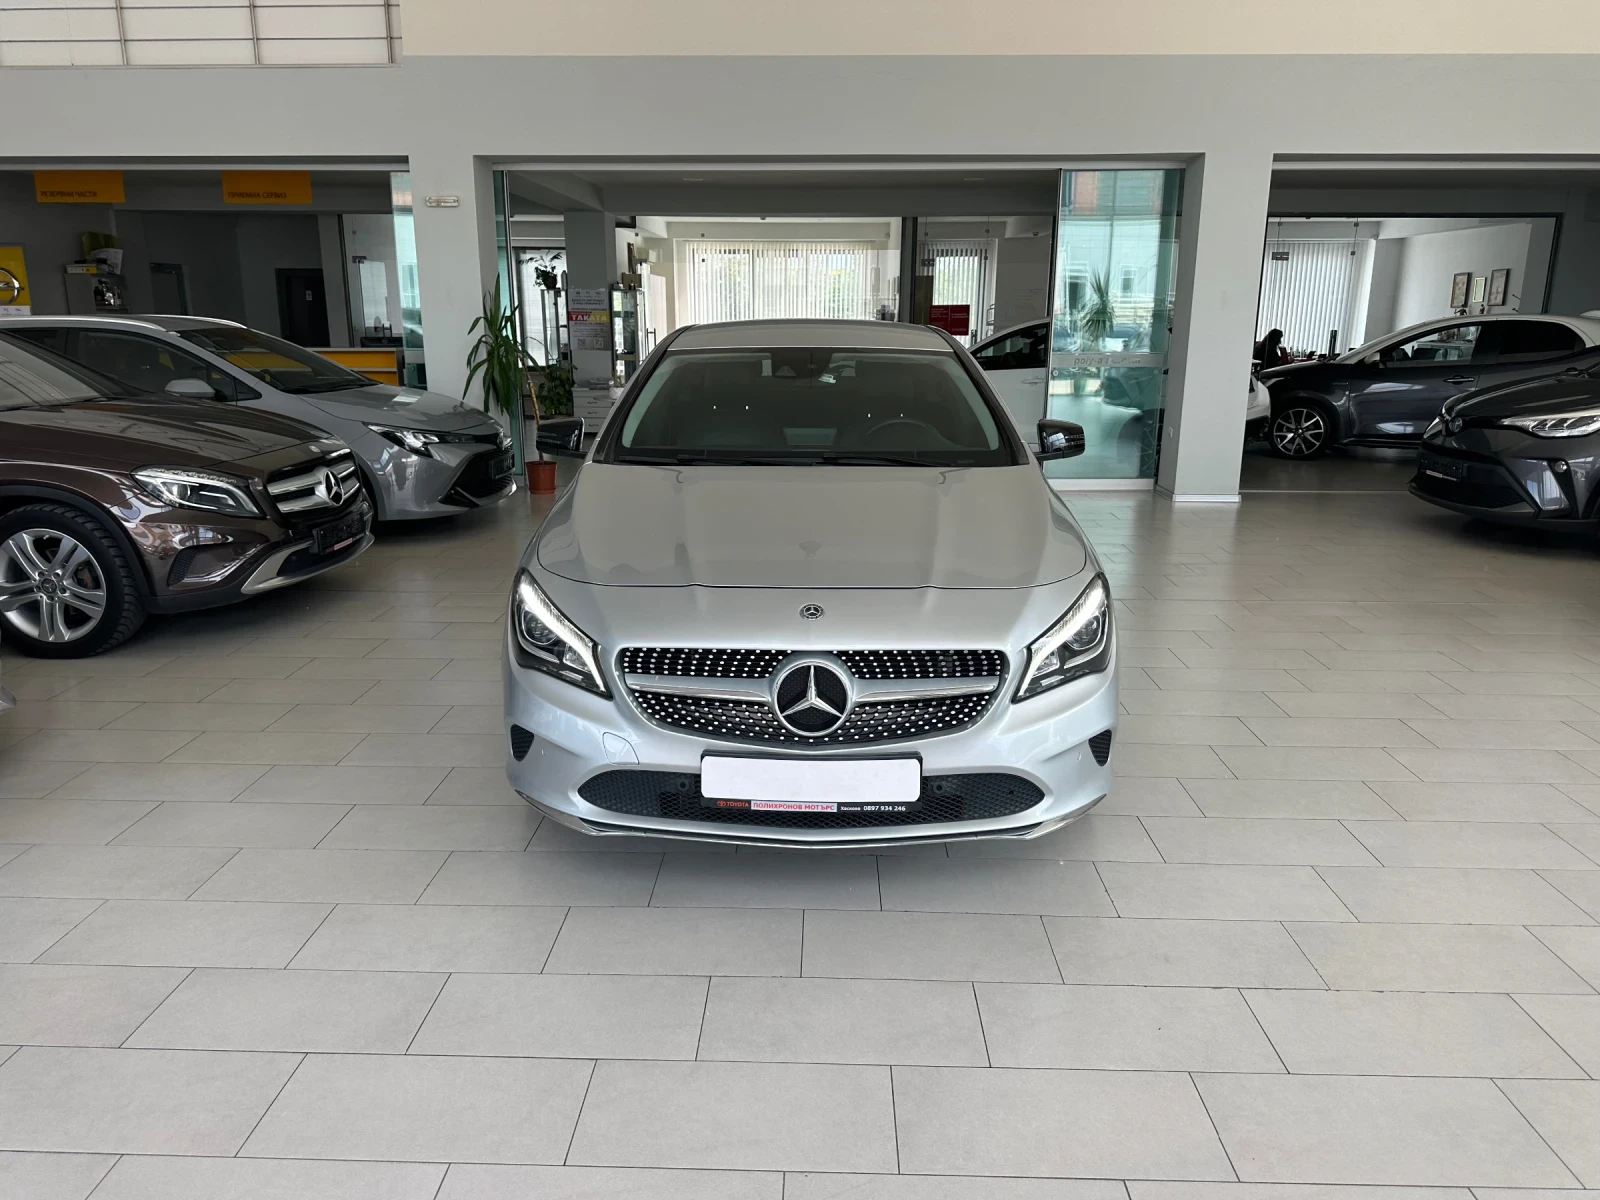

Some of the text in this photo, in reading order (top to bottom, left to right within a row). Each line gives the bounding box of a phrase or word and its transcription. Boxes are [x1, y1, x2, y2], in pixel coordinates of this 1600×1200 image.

[75, 190, 98, 198] ЧАСТИ
[228, 191, 287, 199] ПРИЕМНА СЕРВИЗ
[753, 802, 803, 810] ПОЛИХРОНОВ
